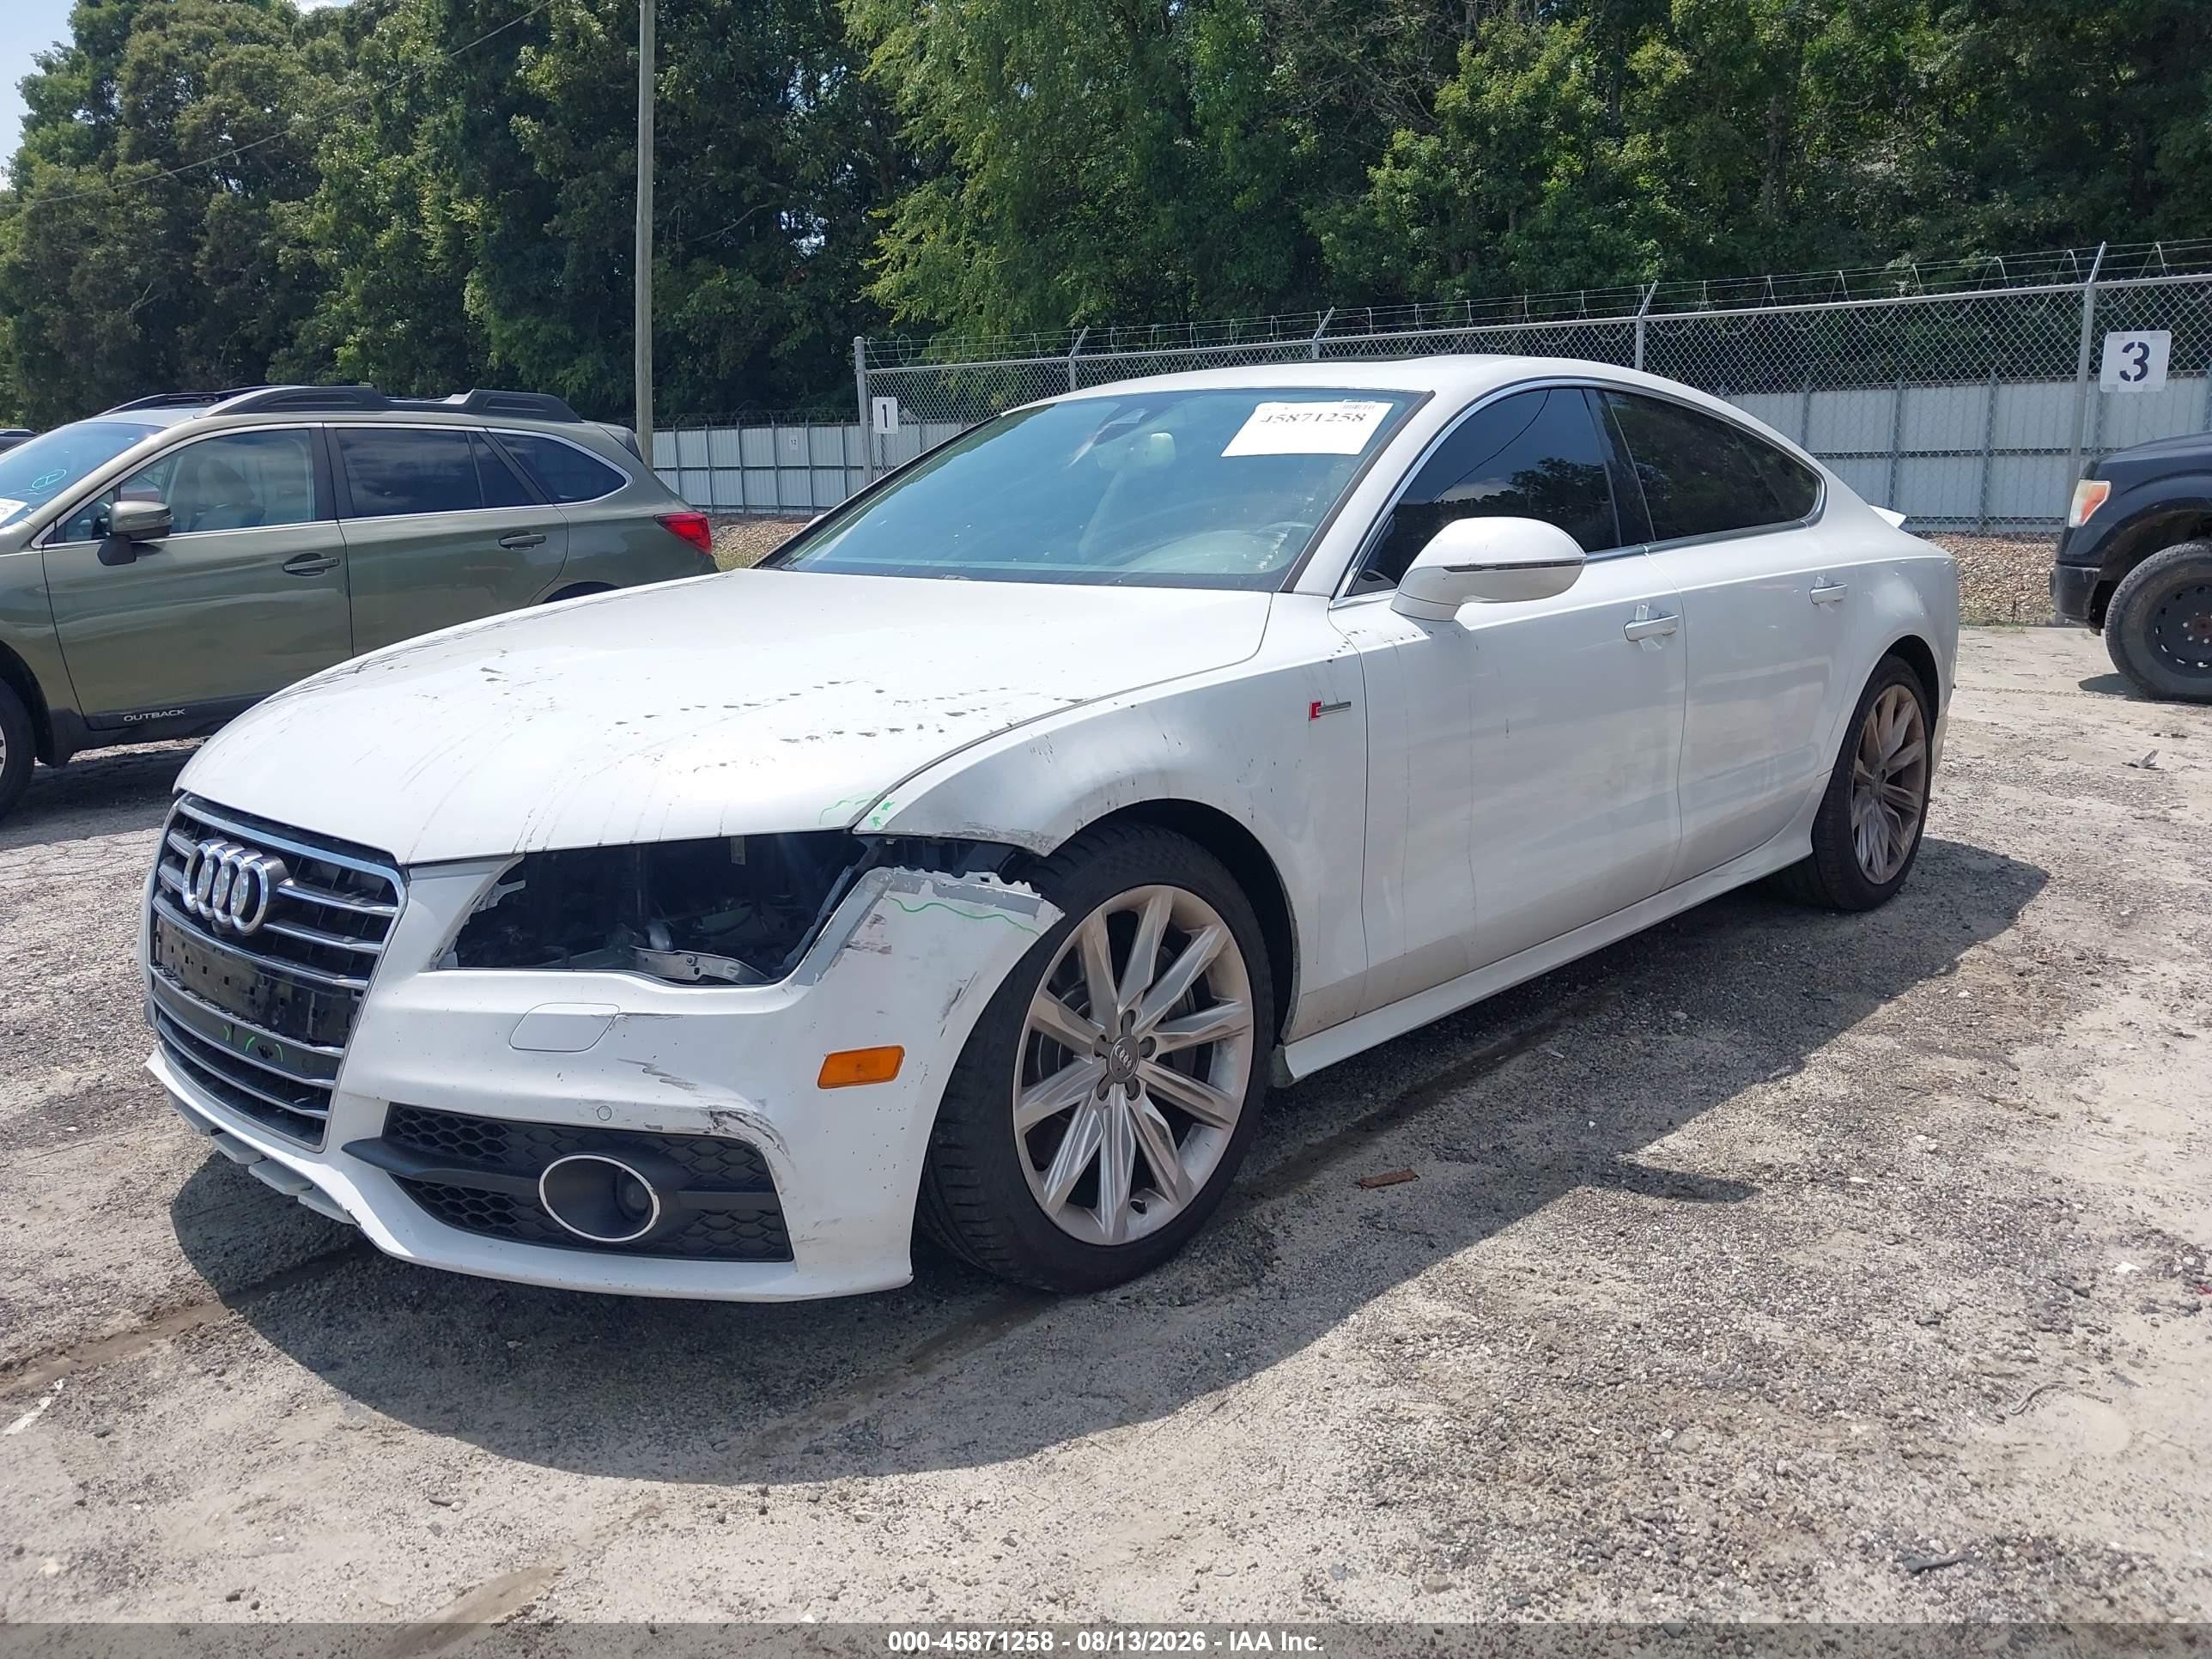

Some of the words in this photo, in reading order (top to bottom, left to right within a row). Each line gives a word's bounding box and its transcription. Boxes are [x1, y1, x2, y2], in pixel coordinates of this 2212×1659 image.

[2119, 341, 2150, 382] 3
[881, 404, 888, 428] 1
[1259, 412, 1367, 424] 45871258
[123, 708, 186, 722] OUTBACK
